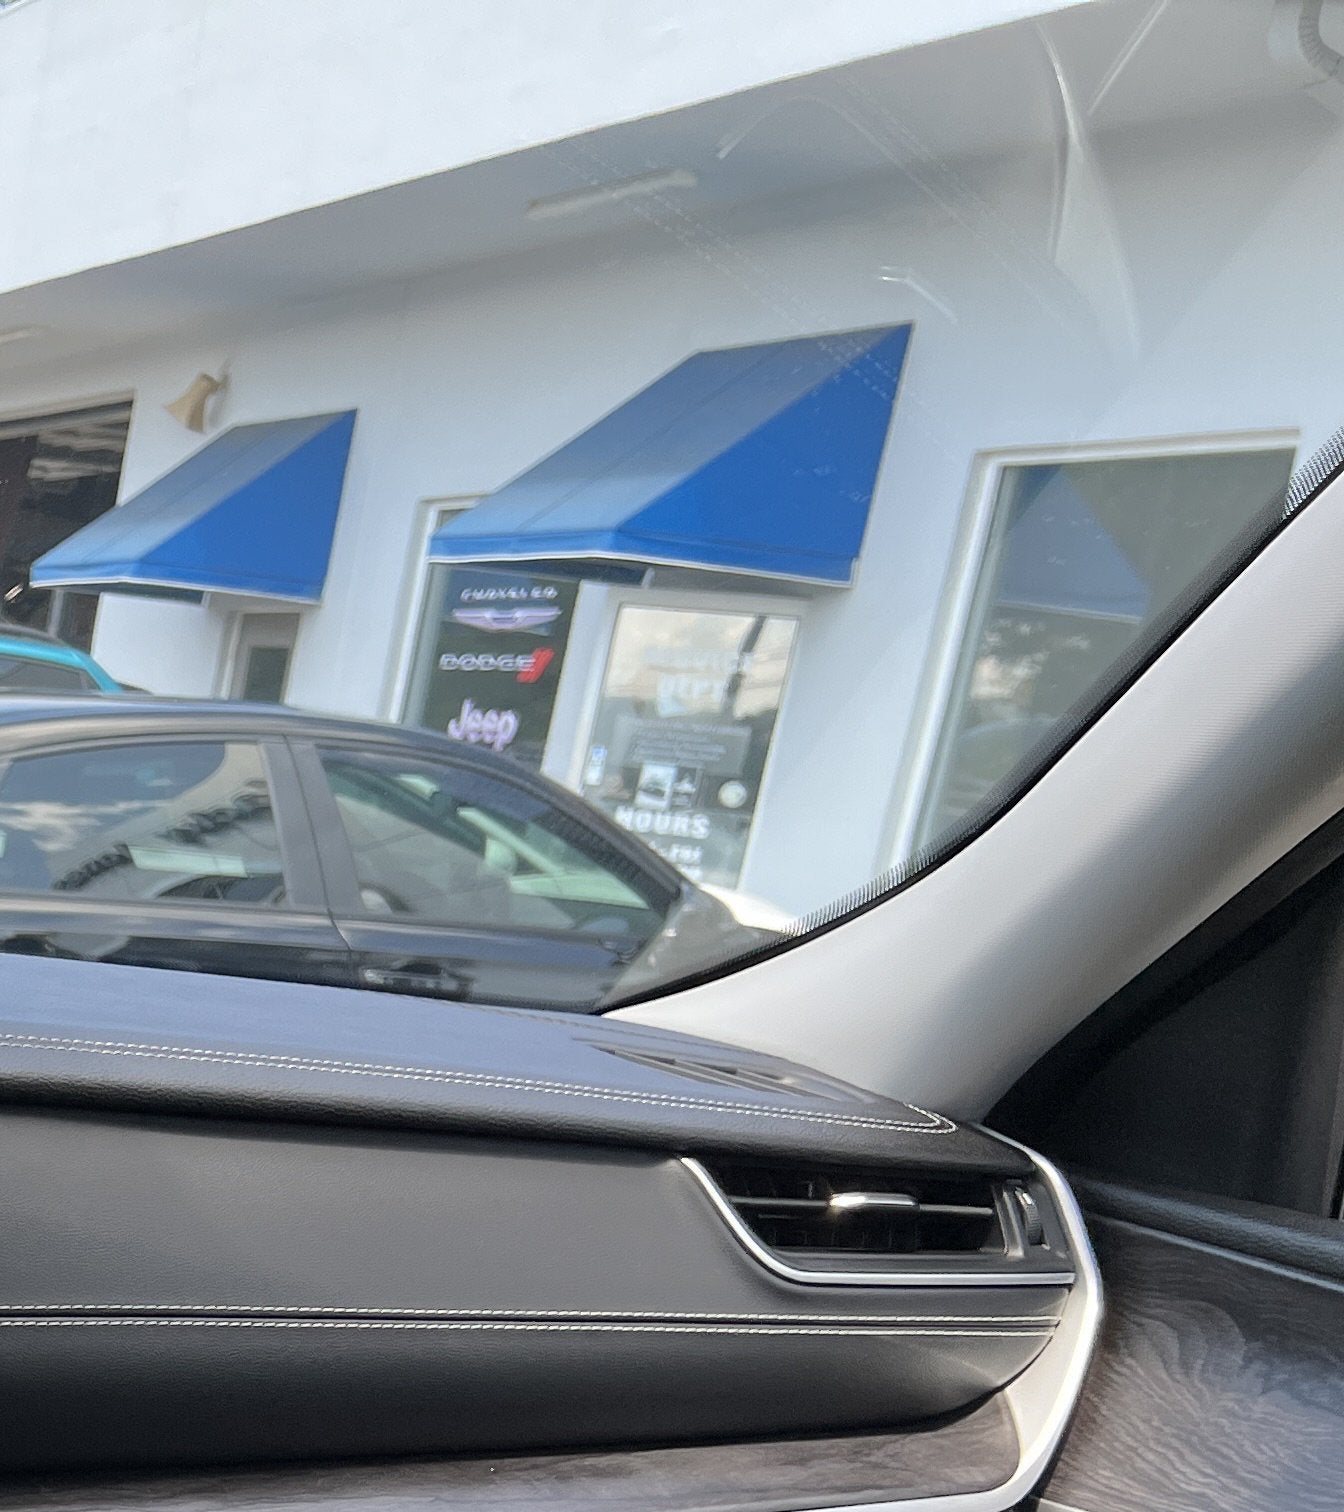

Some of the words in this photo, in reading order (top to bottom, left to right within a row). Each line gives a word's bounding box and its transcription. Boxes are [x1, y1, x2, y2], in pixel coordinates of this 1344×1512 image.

[439, 653, 536, 672] DODGE
[447, 699, 520, 752] Jeep
[615, 804, 711, 840] HOURS
